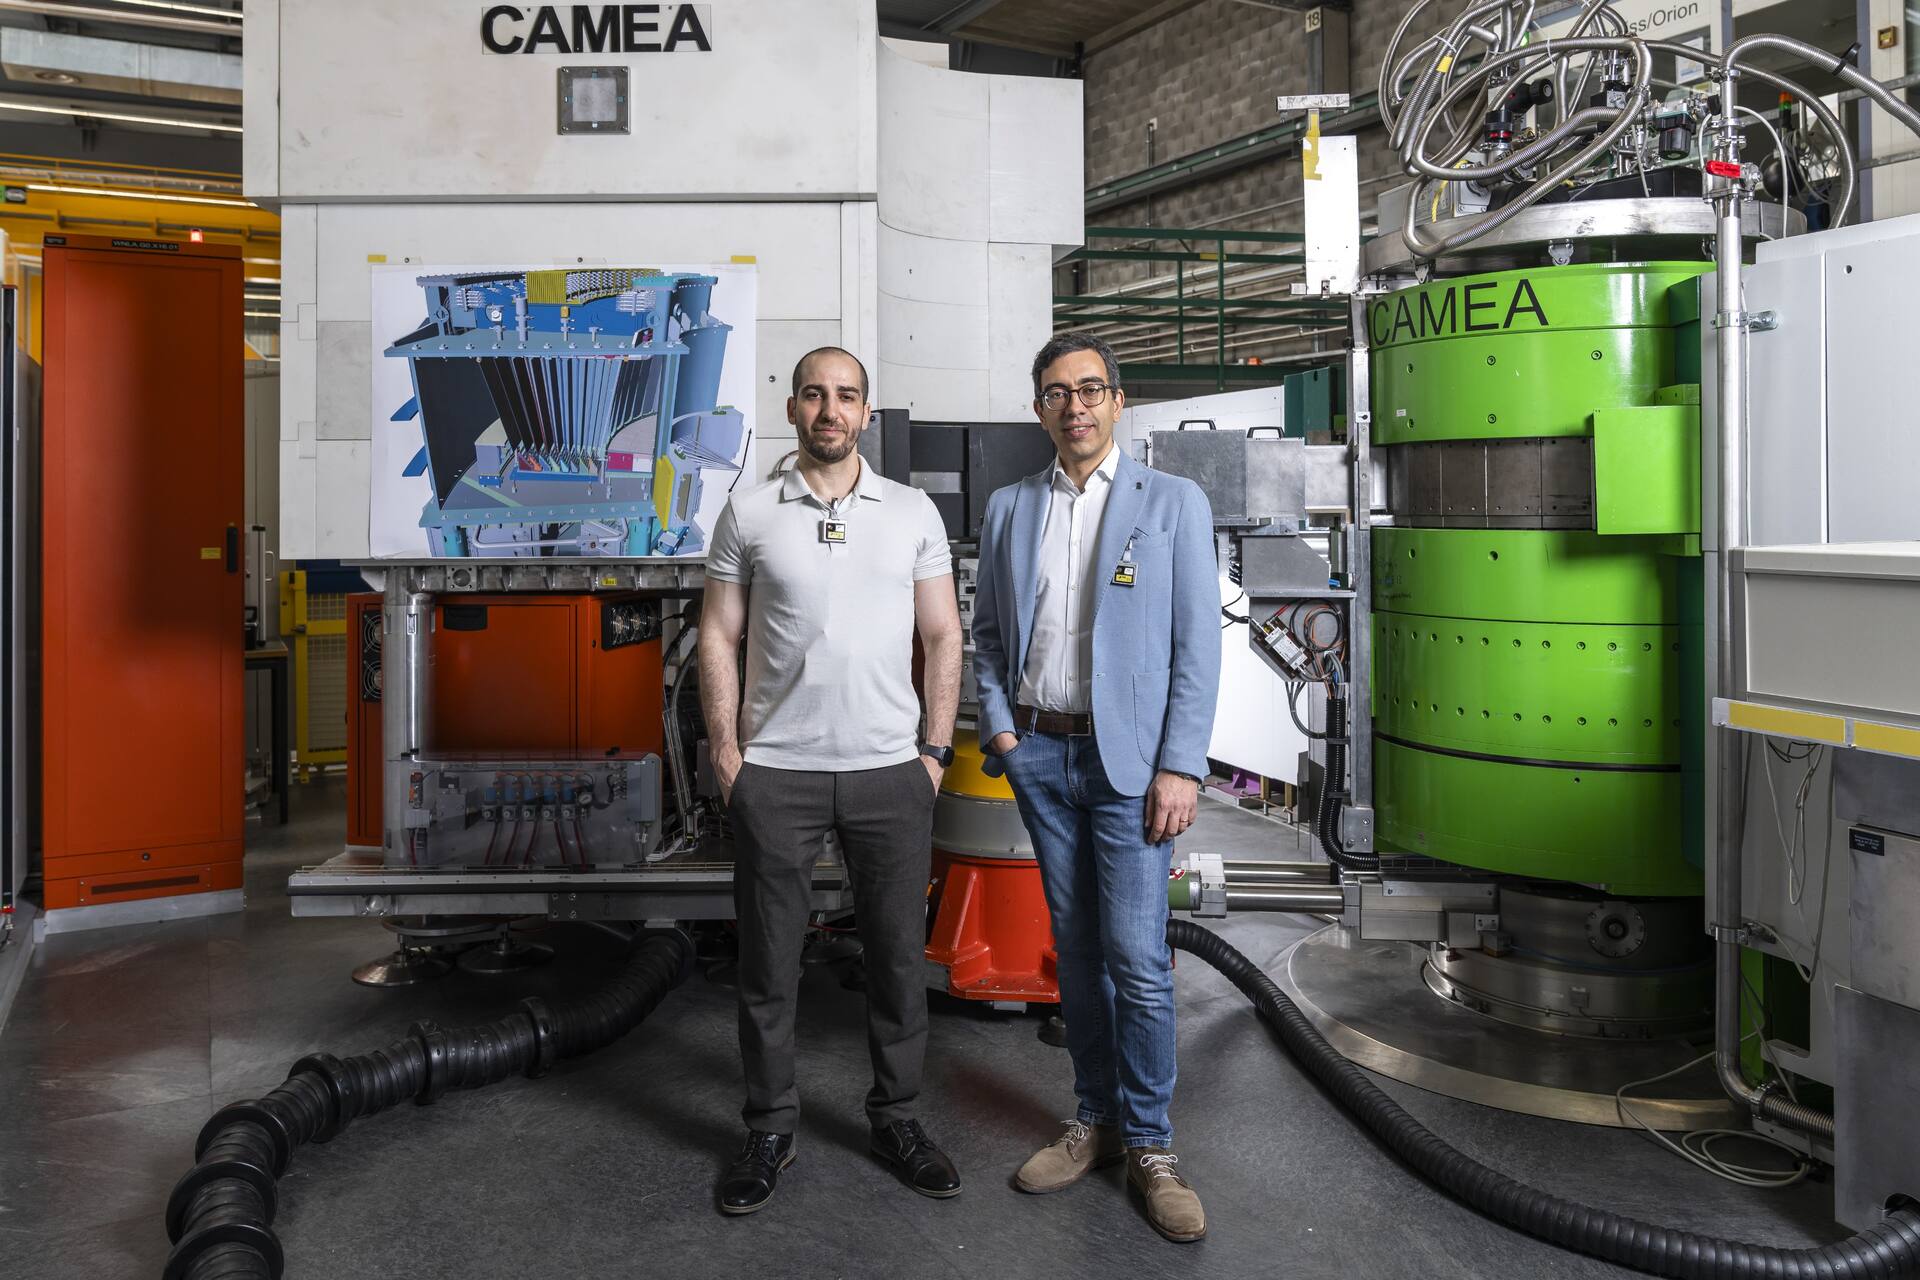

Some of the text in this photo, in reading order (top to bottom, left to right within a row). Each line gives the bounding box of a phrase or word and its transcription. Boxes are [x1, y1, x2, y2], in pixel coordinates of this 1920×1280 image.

[482, 4, 713, 54] CAMEA
[1307, 11, 1320, 29] 18
[1373, 279, 1549, 345] CAMEA
